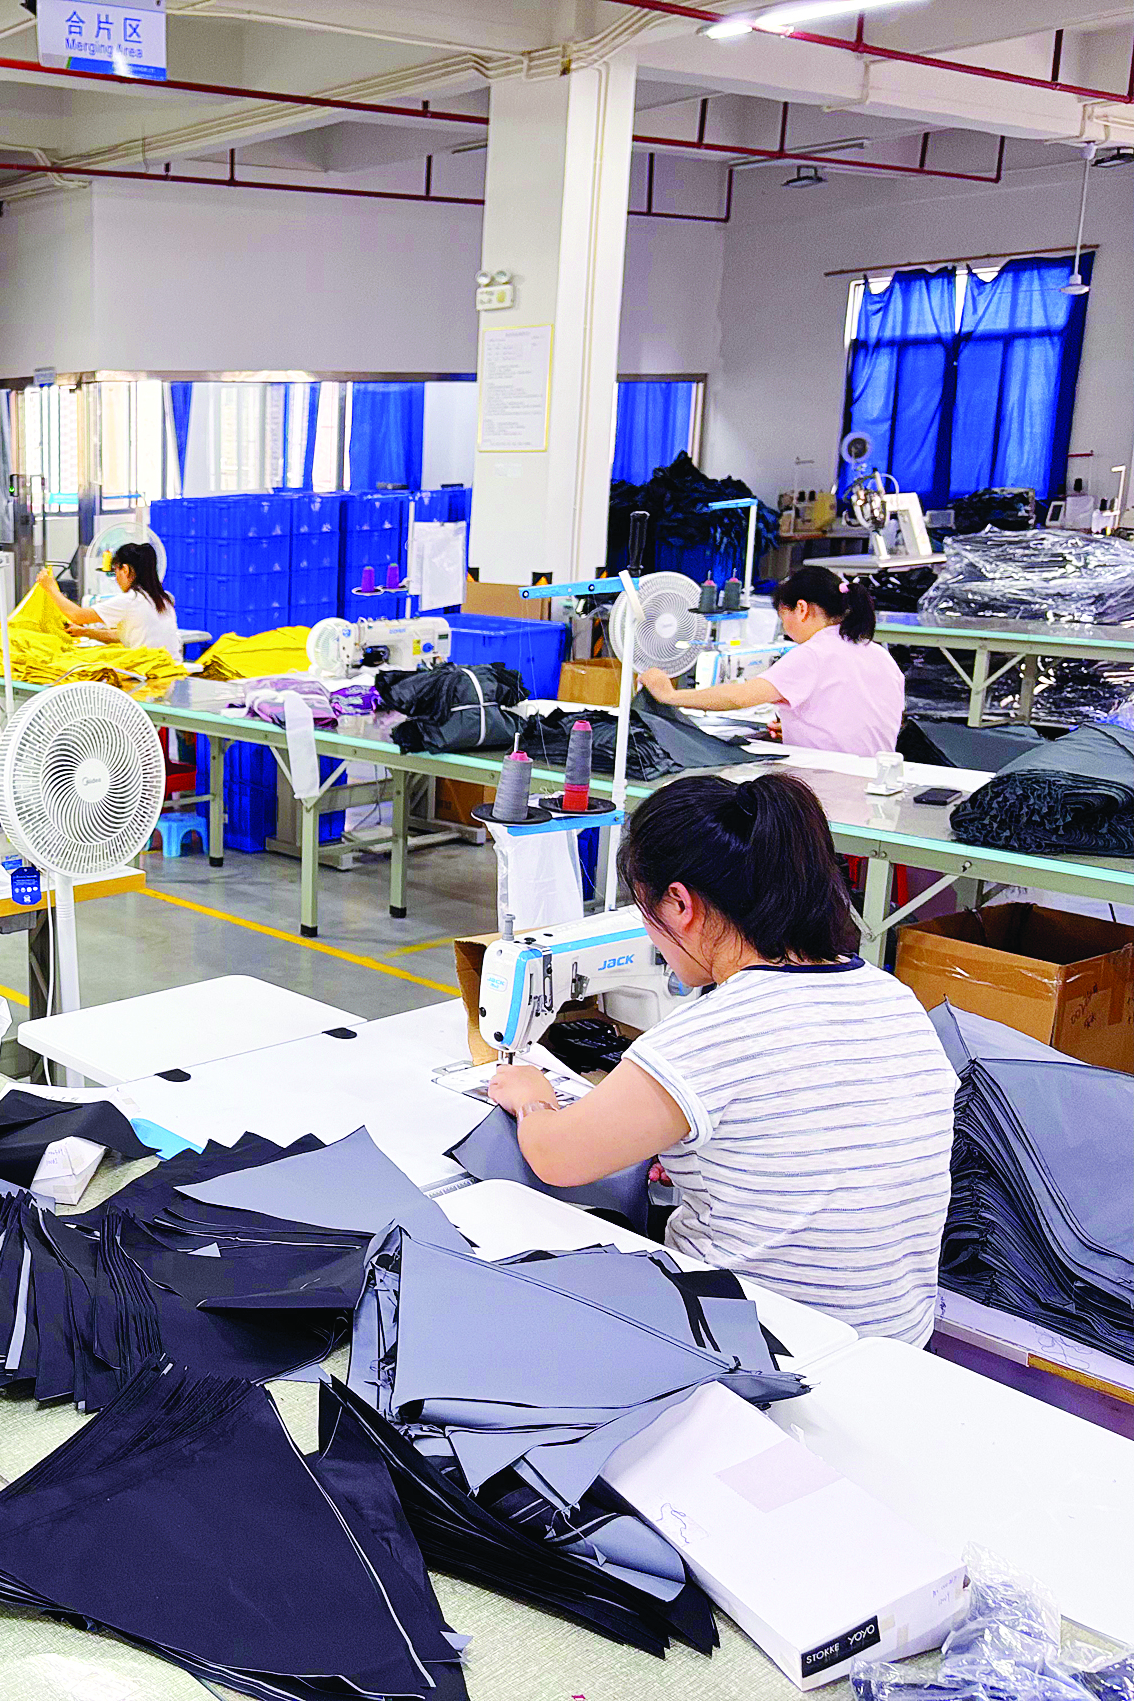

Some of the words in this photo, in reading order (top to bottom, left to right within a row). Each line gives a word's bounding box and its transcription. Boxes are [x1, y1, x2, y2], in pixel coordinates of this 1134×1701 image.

[65, 10, 143, 44] 合片区
[65, 37, 114, 58] Merging
[806, 1643, 839, 1664] STOKKE
[847, 1624, 874, 1645] YOYO
